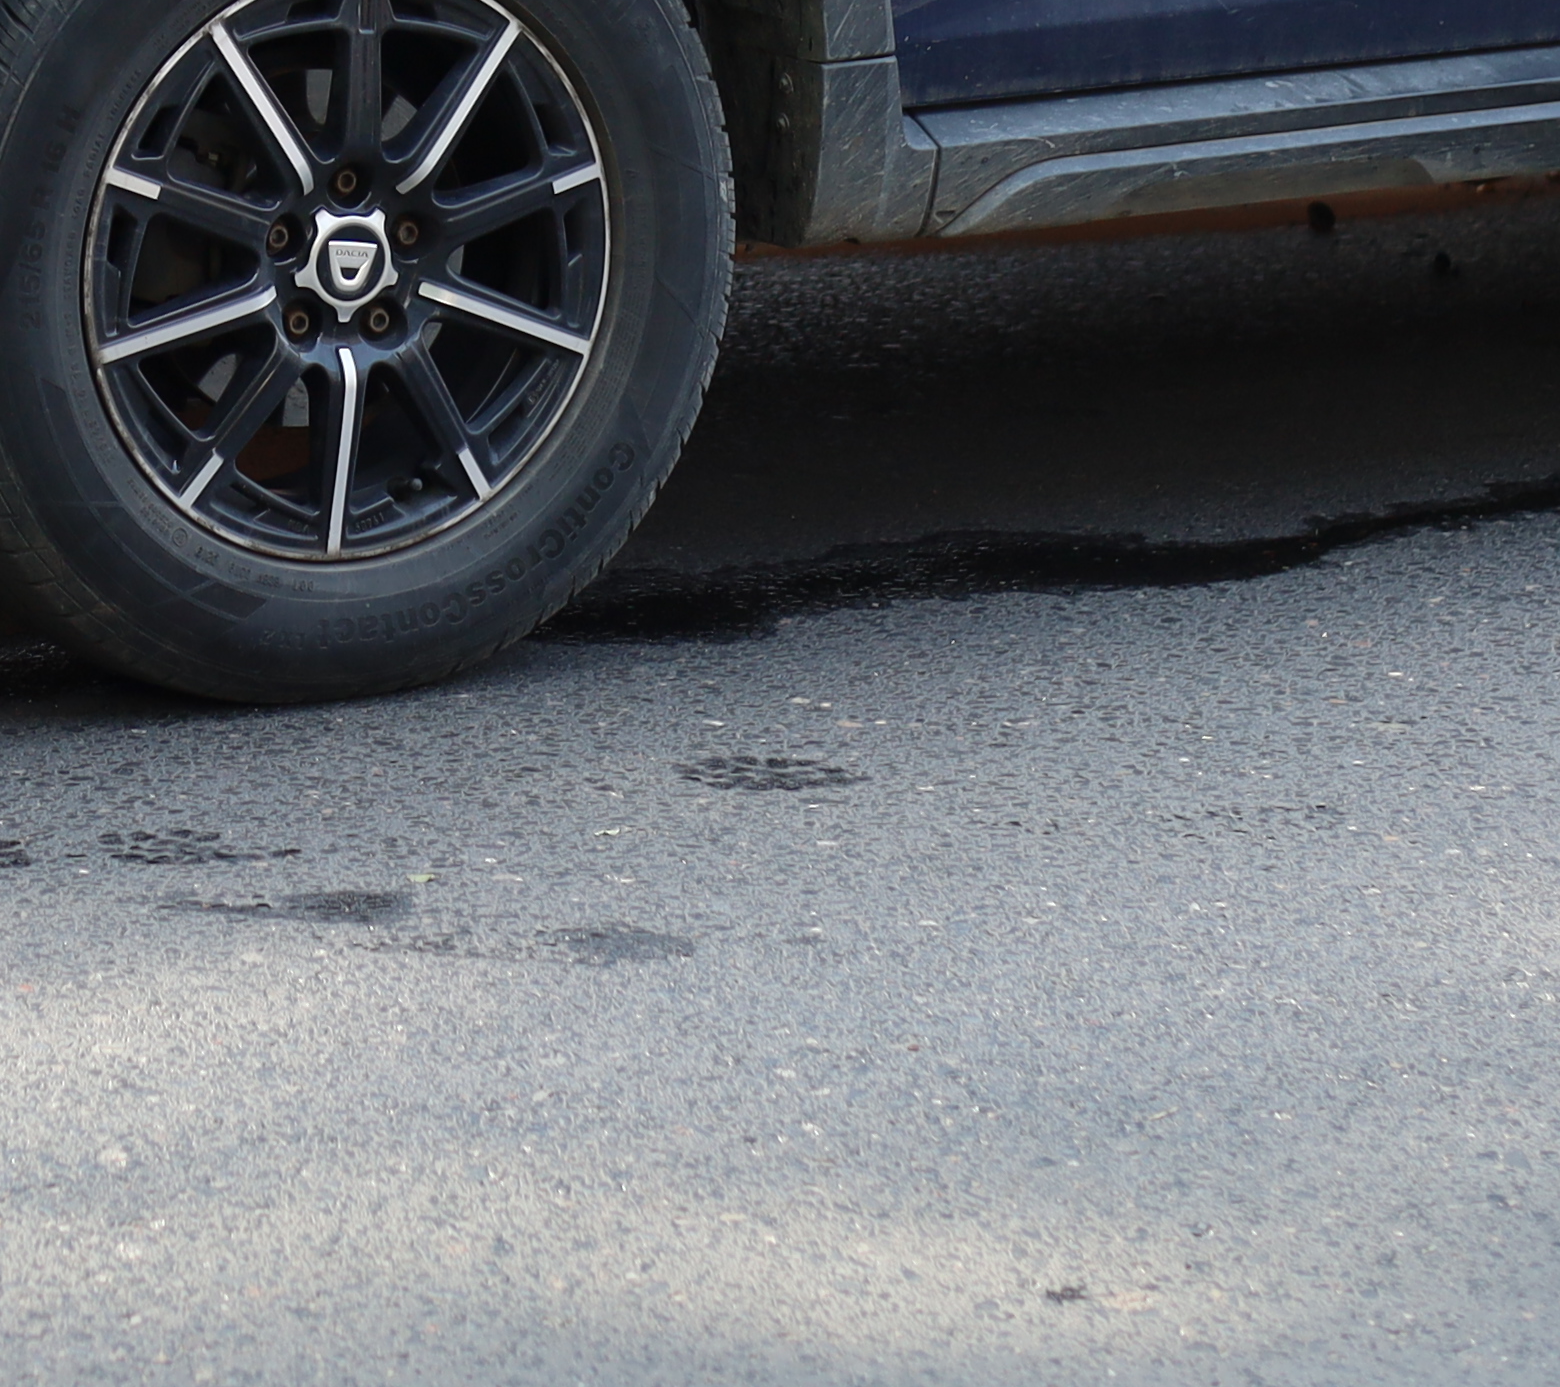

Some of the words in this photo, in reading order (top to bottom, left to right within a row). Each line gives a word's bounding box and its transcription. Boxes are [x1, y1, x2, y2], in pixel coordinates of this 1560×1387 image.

[56, 105, 81, 134] H
[42, 139, 68, 174] 16
[30, 185, 54, 211] R
[335, 248, 369, 258] DACIA
[19, 220, 47, 331] 215/65
[317, 441, 636, 649] ContiCrossContact
